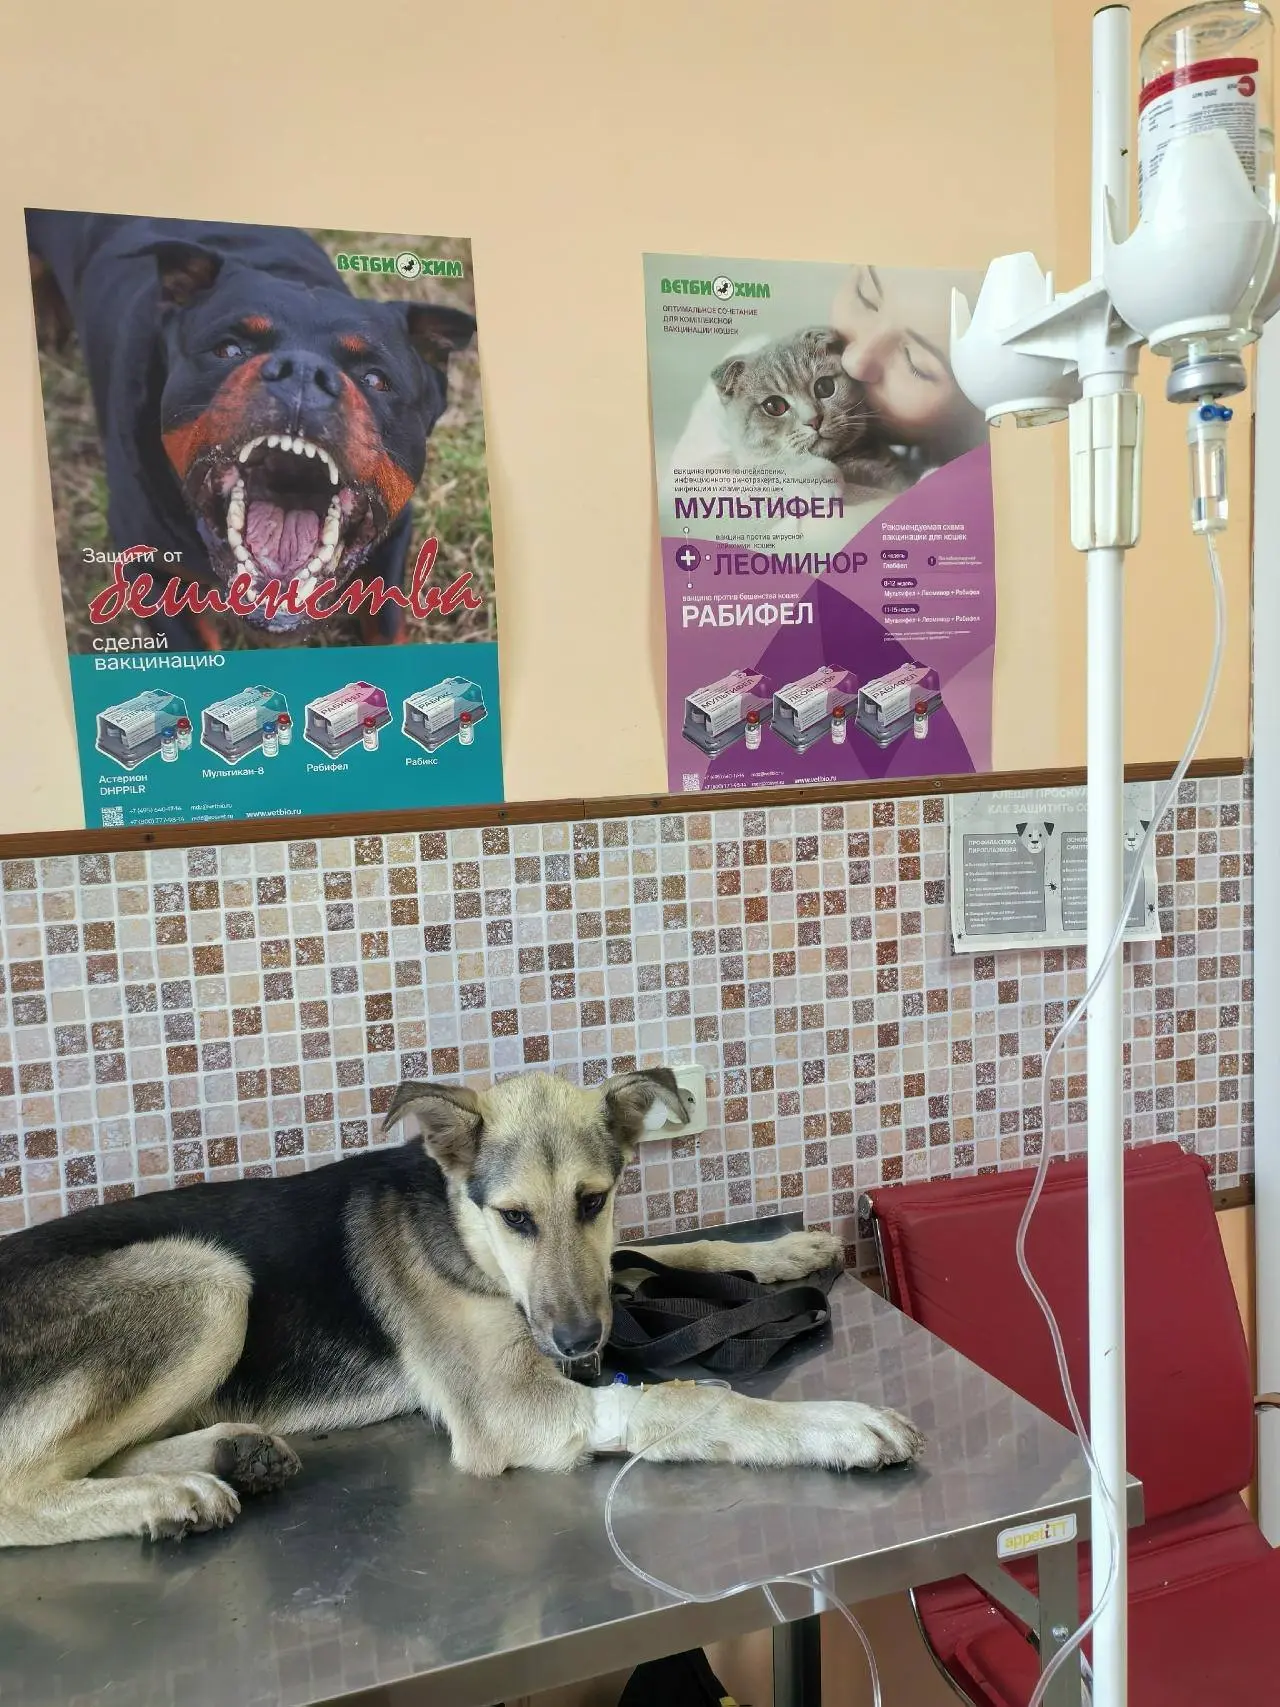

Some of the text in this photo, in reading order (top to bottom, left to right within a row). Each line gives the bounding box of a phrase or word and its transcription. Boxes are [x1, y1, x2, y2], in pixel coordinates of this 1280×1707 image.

[662, 305, 758, 316] ОПТИМАЛЬНОЕ СОЧЕТАНИЕ
[679, 316, 733, 325] КОМПЛЕКСНОЙ
[663, 325, 739, 335] ВАКЦИНАЦИИ КОШЕК
[673, 468, 704, 476] вакцина
[674, 496, 844, 520] МУЛЬТИФЕЛ
[881, 522, 965, 532] Рекомендуемая схема
[772, 533, 804, 541] вирусной
[82, 547, 183, 565] Защити от
[713, 551, 868, 576] ЛЕОМИНОР
[88, 536, 483, 625] бешенства
[713, 594, 738, 602] против
[739, 592, 777, 600] бешенства
[884, 590, 916, 599] Мультифел
[921, 589, 950, 597] Леоминор
[955, 588, 980, 596] Рабифел
[682, 601, 814, 628] РАБИФЕЛ
[92, 632, 169, 653] сделай
[94, 653, 226, 672] вакцинацию
[872, 672, 919, 700] РАБИФЕЛ
[320, 691, 364, 716] РАБИФЕЛ
[418, 691, 454, 711] РАБИКС
[306, 762, 349, 773] Рабифел
[405, 757, 438, 766] Рабикс
[202, 766, 265, 779] Мультикан-8
[98, 773, 149, 785] Астерион
[794, 775, 837, 784] www.vetbio.ru
[245, 807, 302, 819] www.vetbio.ru
[988, 803, 1010, 814] КАК
[1011, 802, 1074, 815] ЗАЩИТИТЬ
